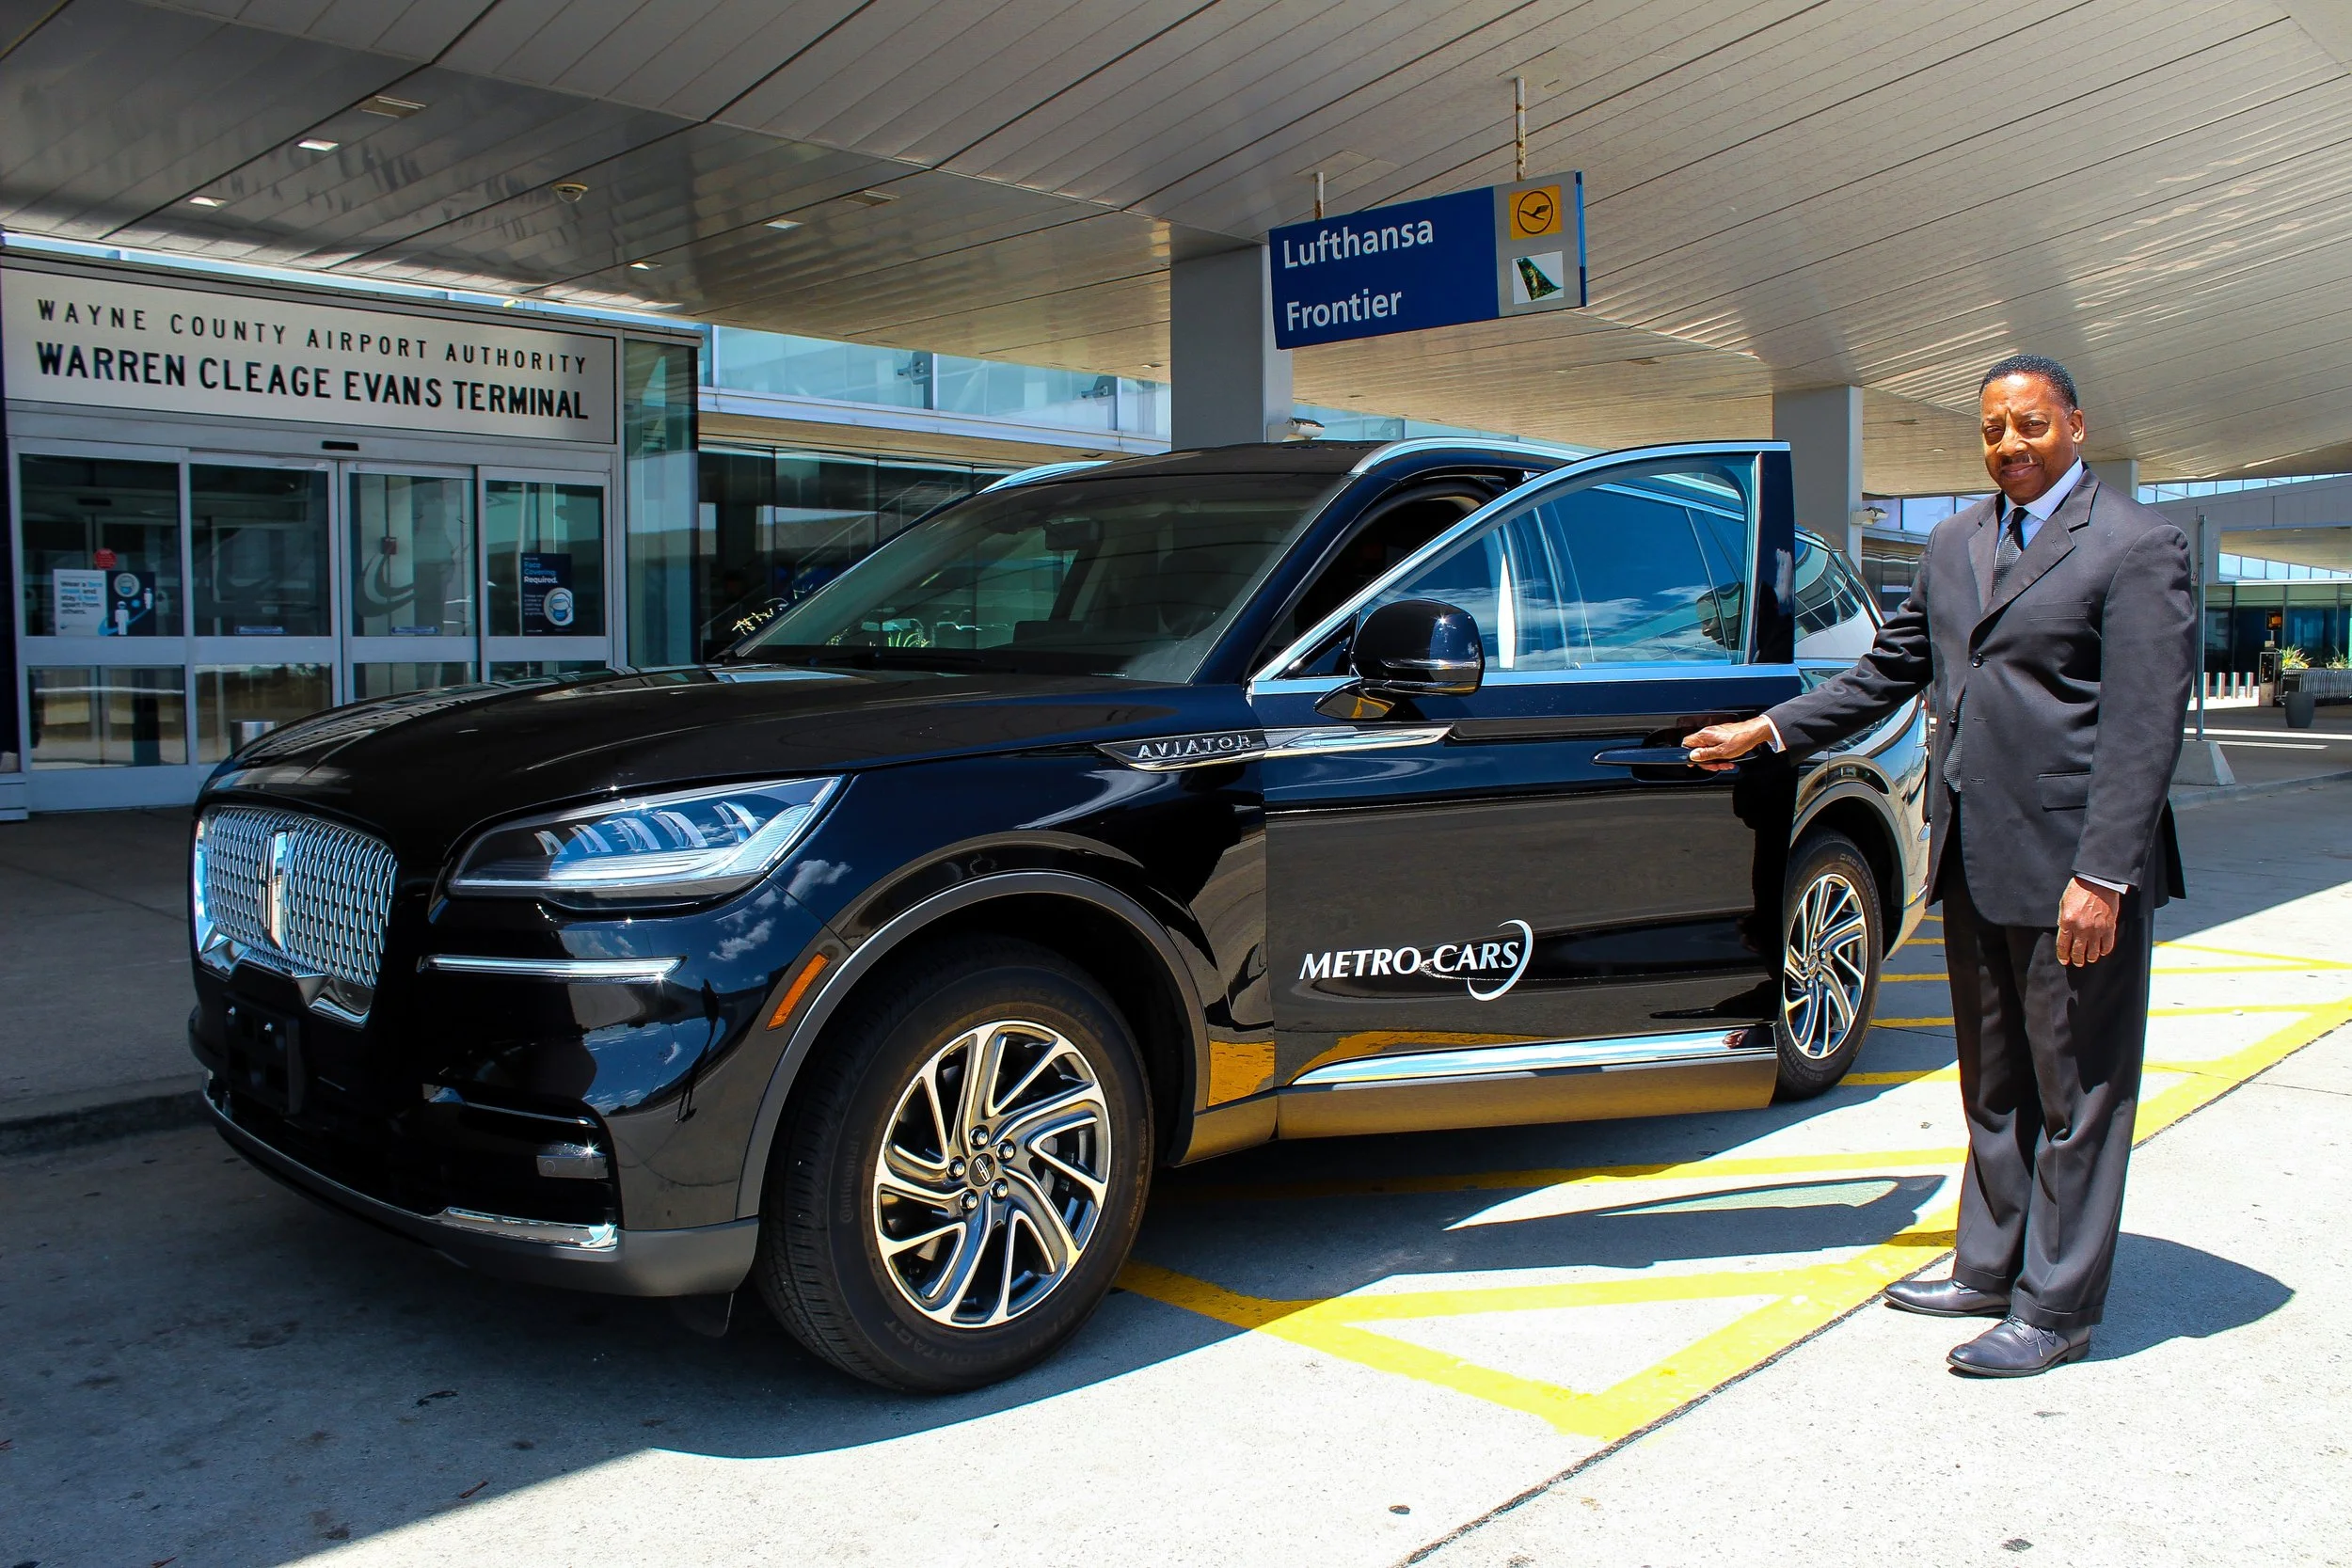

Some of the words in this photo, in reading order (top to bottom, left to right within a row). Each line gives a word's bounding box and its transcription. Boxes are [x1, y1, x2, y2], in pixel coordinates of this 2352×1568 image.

[1283, 219, 1434, 269] Lufthansa
[1286, 288, 1402, 331] Frontier
[37, 298, 147, 331] WAYNE
[170, 313, 286, 345] COUNTY
[307, 328, 427, 359] AIRPORT
[445, 343, 587, 374] AUTHORITY
[36, 341, 186, 387] WARREN
[199, 356, 331, 399] CLEAGE
[344, 370, 443, 407] EVANS
[453, 380, 589, 420] TERMINAL
[523, 576, 558, 584] Required.
[1137, 734, 1252, 759] AVIATOR
[1298, 945, 1422, 980] METRO
[1433, 941, 1519, 973] CARS
